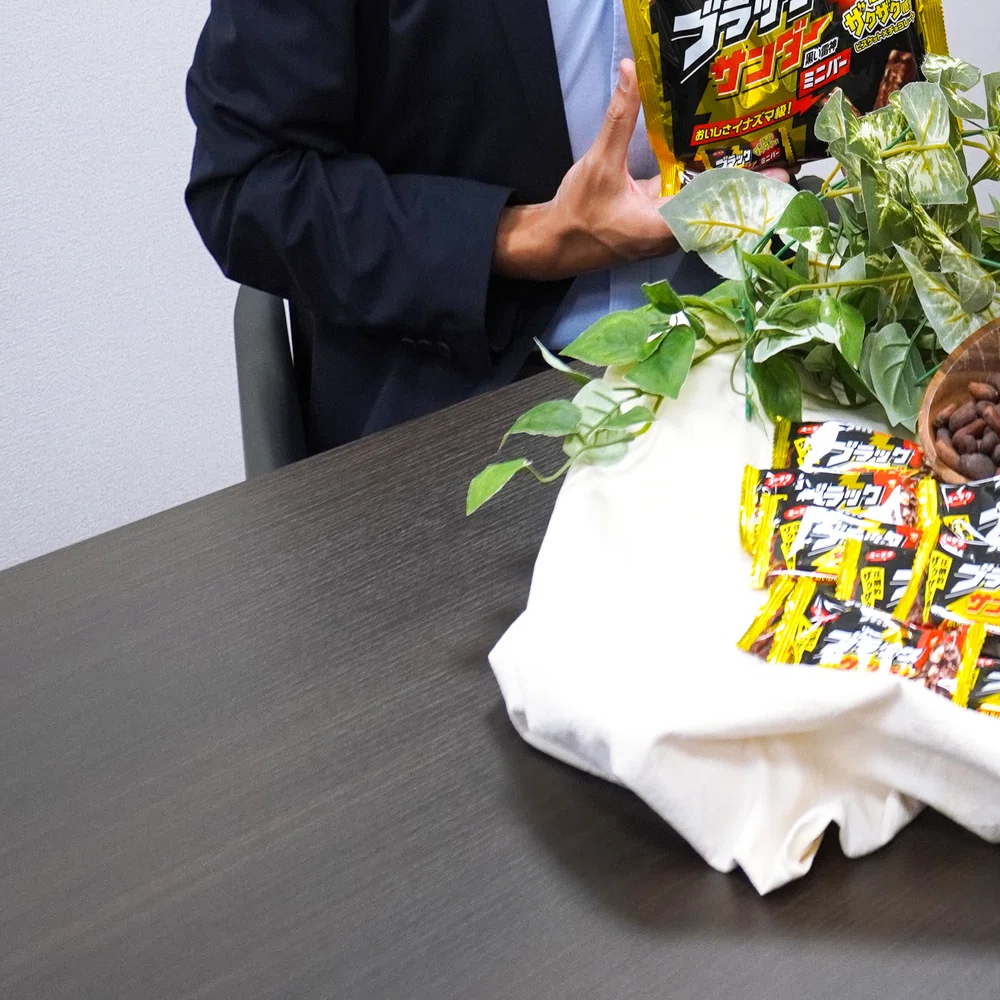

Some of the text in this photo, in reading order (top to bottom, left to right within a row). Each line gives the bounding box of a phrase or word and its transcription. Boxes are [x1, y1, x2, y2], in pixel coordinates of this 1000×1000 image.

[712, 12, 832, 98] サンダー
[804, 39, 838, 67] 黒い雷神
[803, 55, 848, 90] ミニバー
